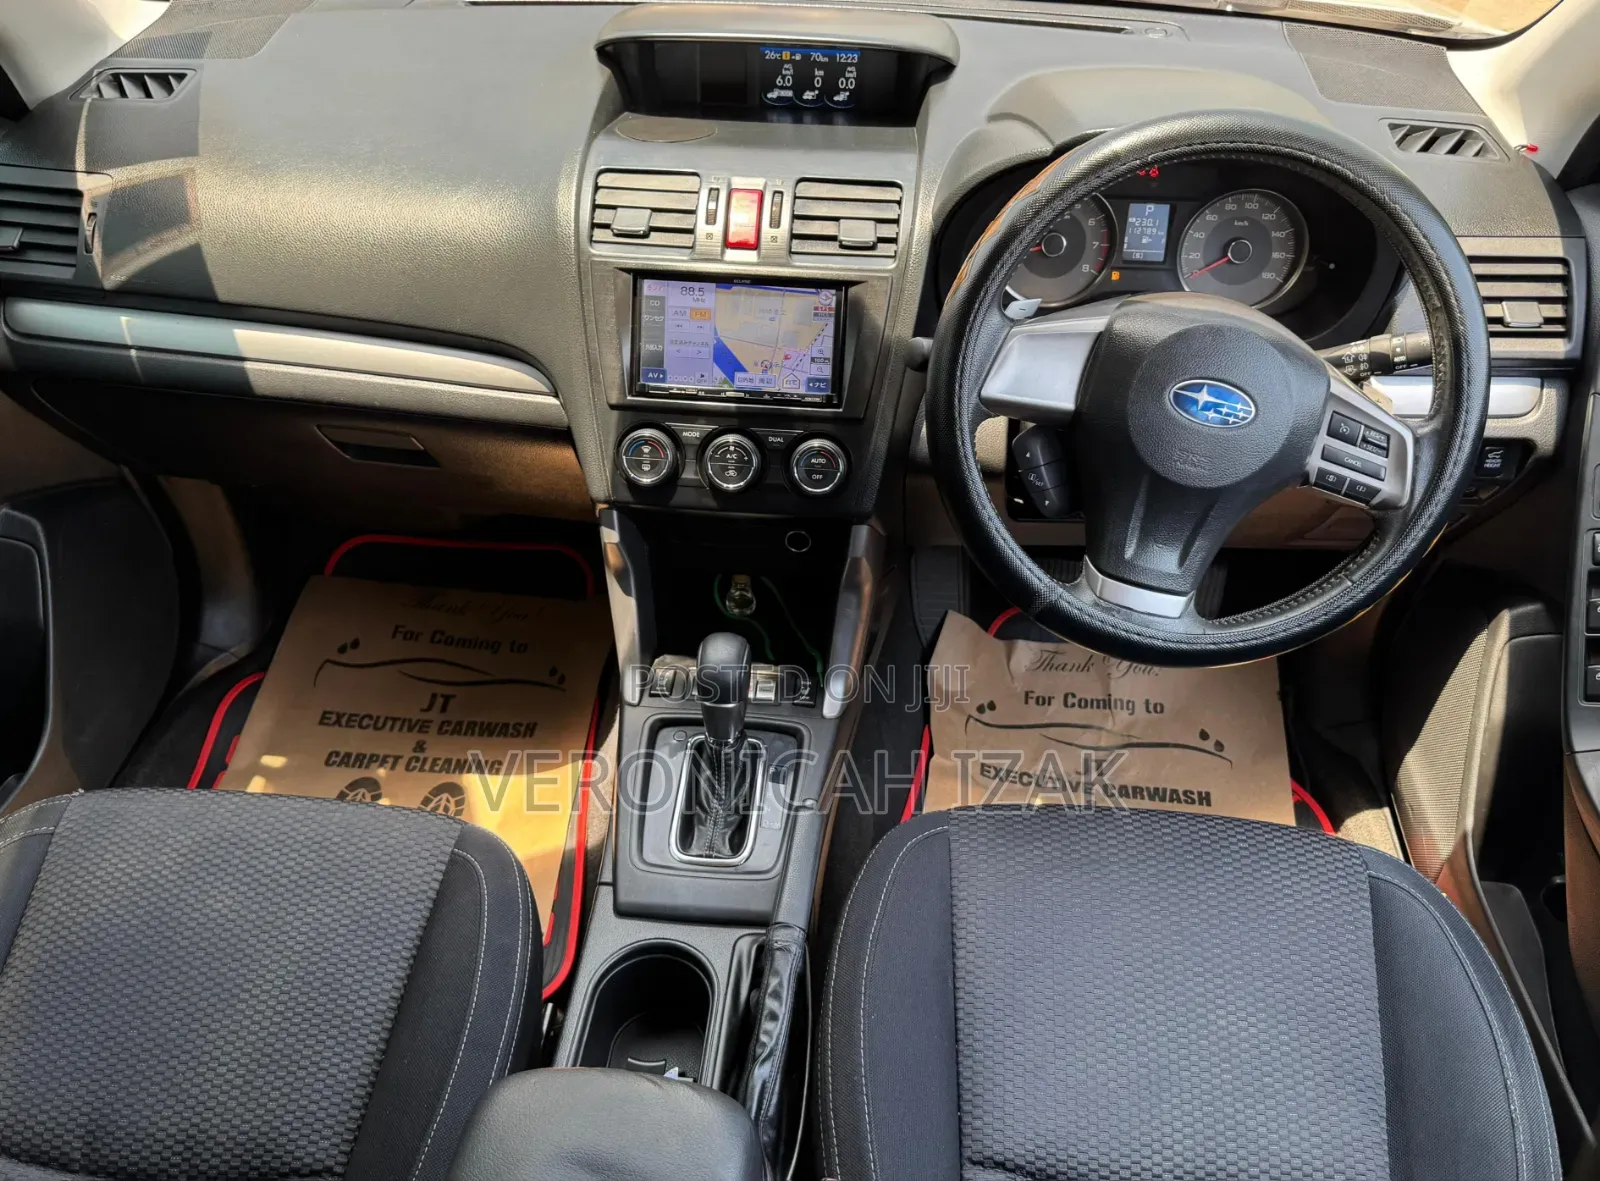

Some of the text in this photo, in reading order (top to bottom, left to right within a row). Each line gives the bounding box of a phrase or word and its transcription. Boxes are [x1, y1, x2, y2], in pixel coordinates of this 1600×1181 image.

[836, 53, 858, 63] 12:23
[776, 75, 792, 86] 6.0
[814, 77, 822, 88] 0
[838, 78, 855, 89] 0.0
[1145, 204, 1155, 216] P
[1088, 218, 1096, 226] 6
[1193, 231, 1205, 239] 40
[1092, 241, 1100, 249] 7
[1081, 264, 1090, 272] 8
[680, 286, 705, 297] 88.5
[682, 430, 700, 438] MODE
[810, 457, 827, 465] AUTO
[1344, 456, 1362, 467] CANCEL
[391, 624, 529, 655] For Coming to
[1024, 649, 1095, 673] Thank
[420, 692, 457, 713] JT
[1024, 690, 1165, 716] For Coming to
[318, 710, 538, 739] EXECUTIVE CARWASH
[412, 739, 428, 753] &
[324, 750, 504, 775] CARPET CLEANING
[980, 762, 1212, 807] EXECUTIVE CARWASH
